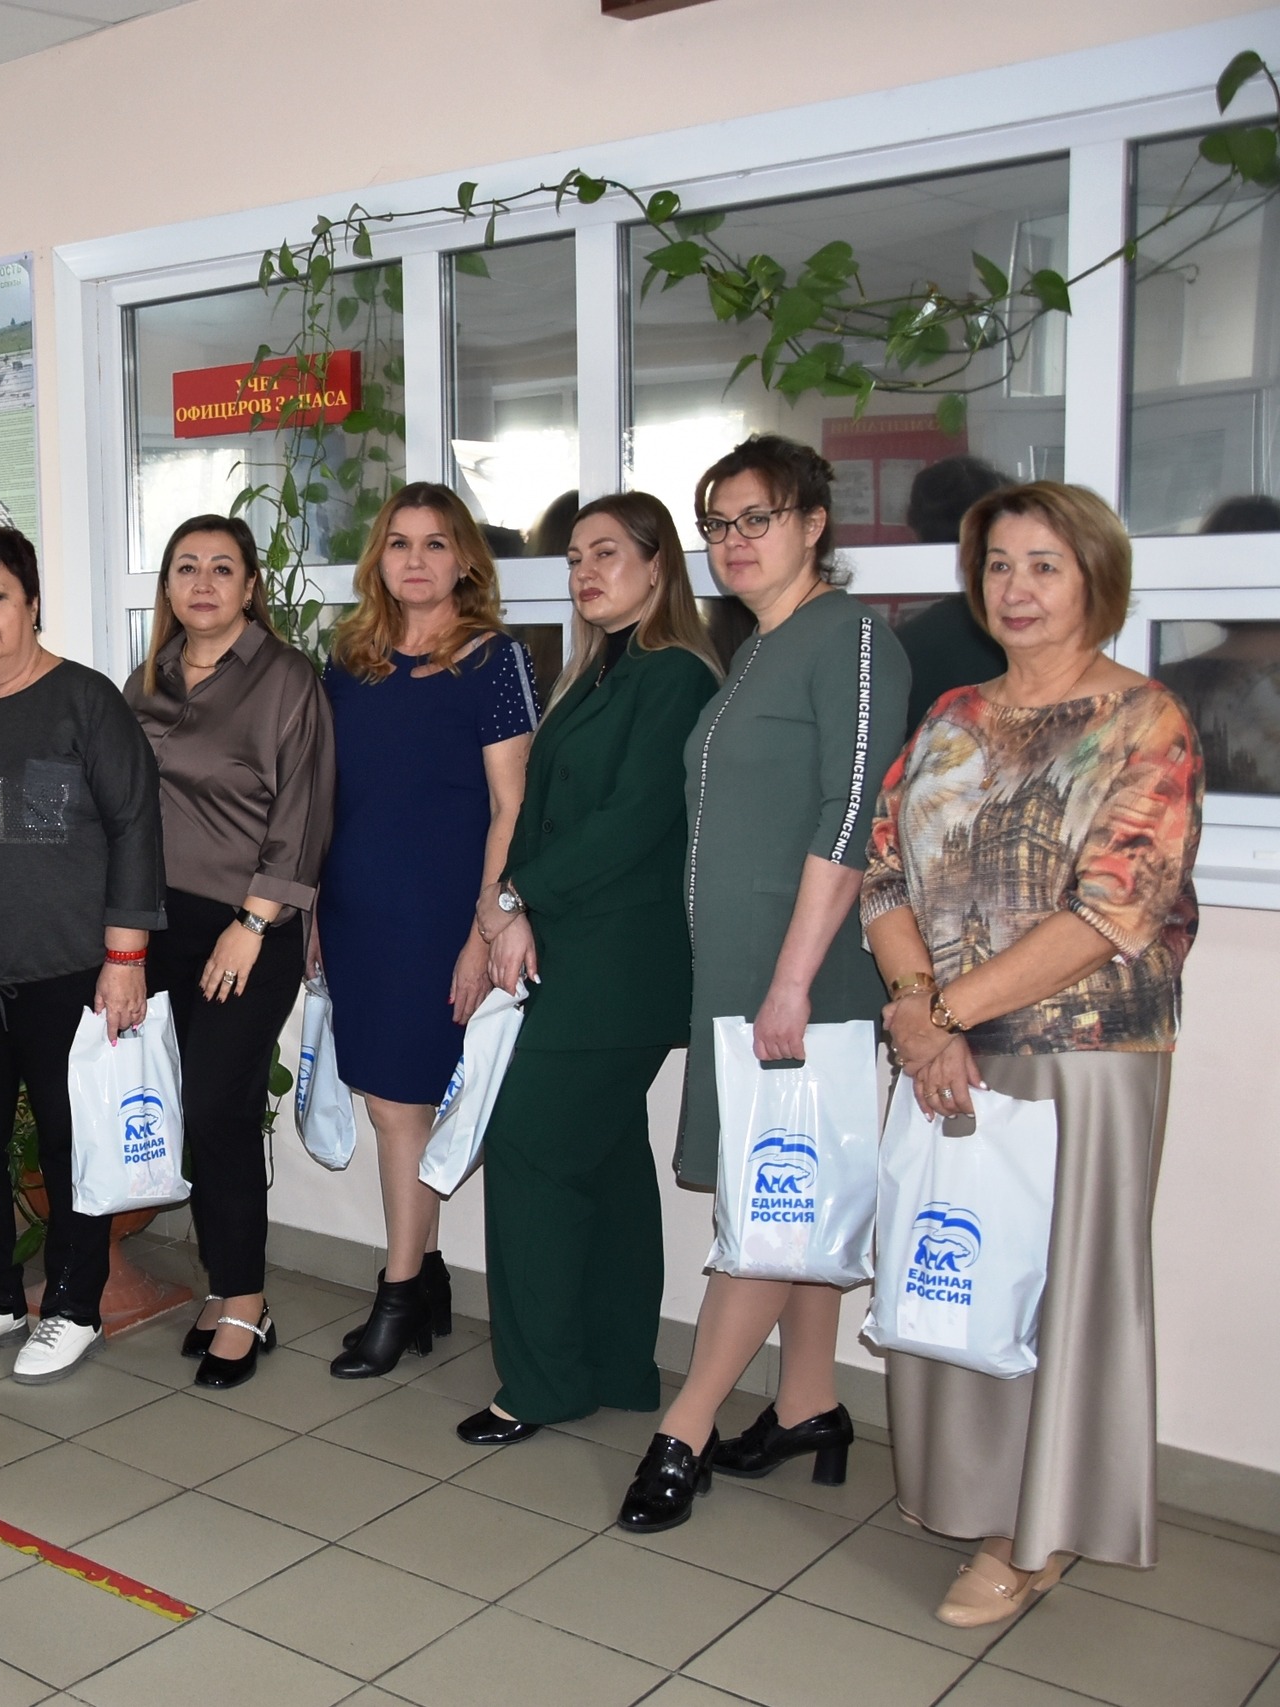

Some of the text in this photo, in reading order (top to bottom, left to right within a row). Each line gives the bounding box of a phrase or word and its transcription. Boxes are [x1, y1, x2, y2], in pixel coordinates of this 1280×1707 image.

[175, 389, 348, 423] ОФИЦЕРОВ ЗПАСА
[123, 1137, 165, 1154] ЕДИНАЯ
[124, 1147, 166, 1164] РОССИЯ
[751, 1197, 814, 1210] ЕДИНАЯ
[750, 1211, 815, 1223] РОССИЯ
[908, 1268, 973, 1291] ЕДИНАЯ
[906, 1281, 972, 1306] РОССИЯ
